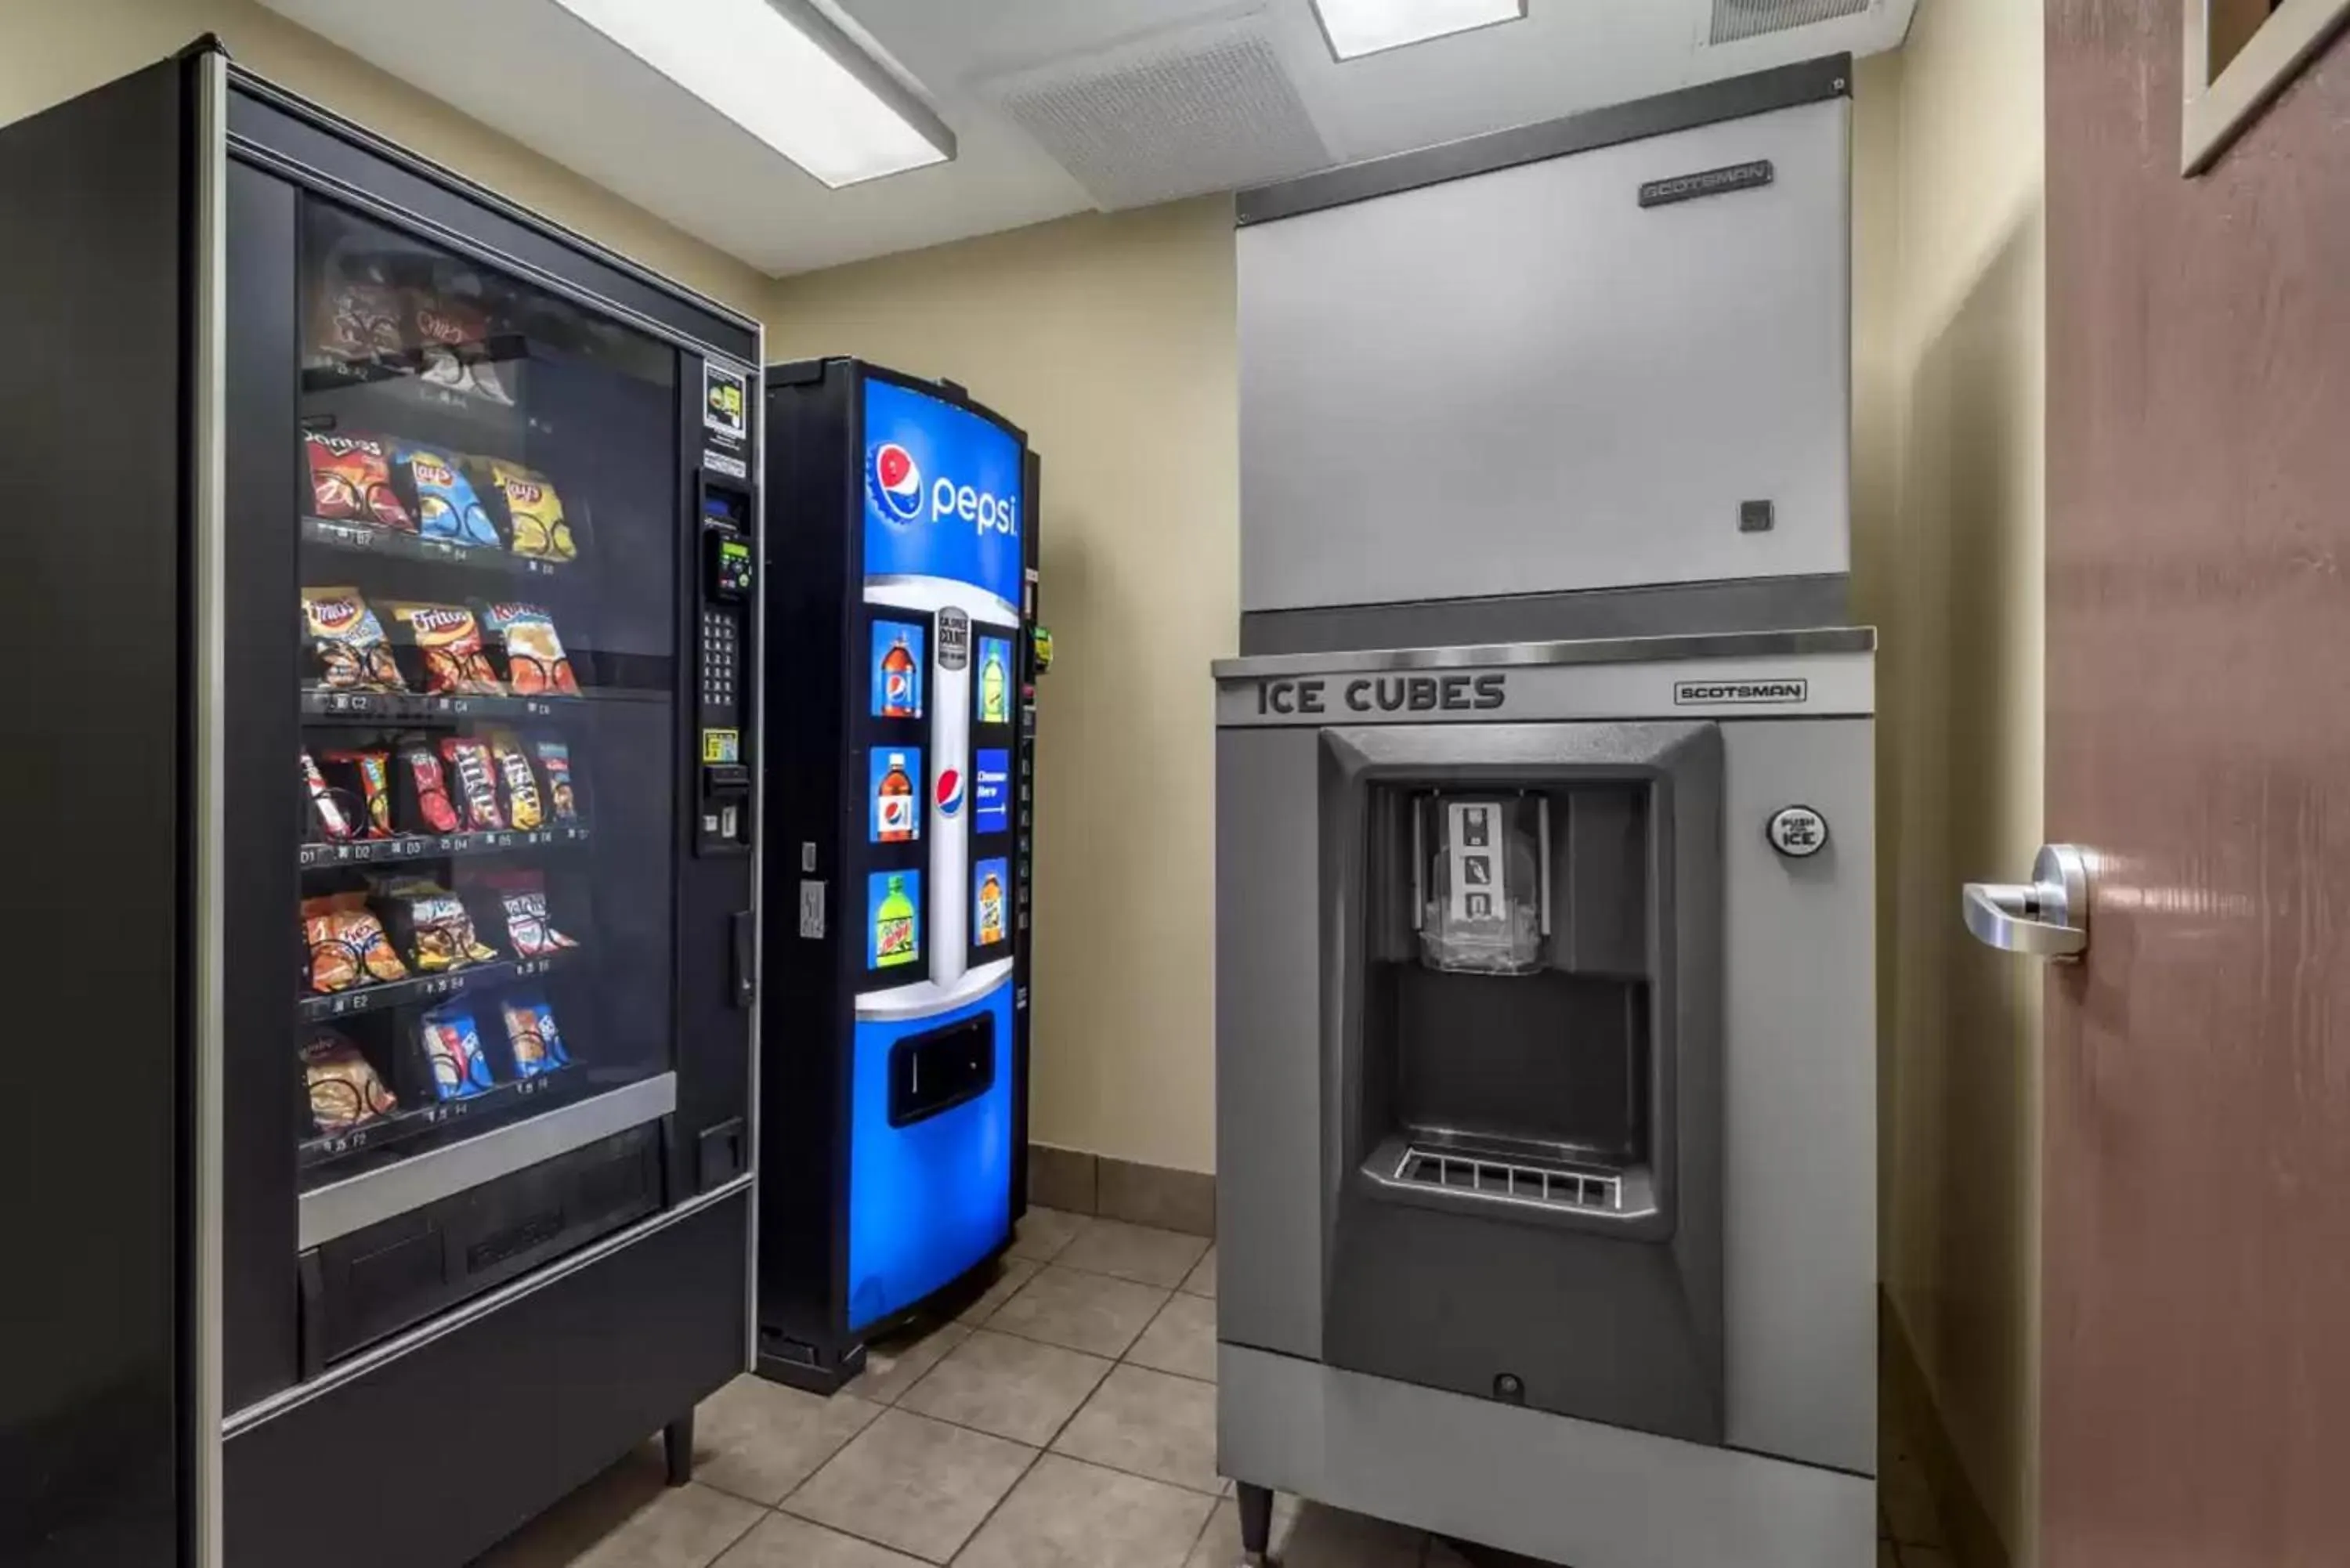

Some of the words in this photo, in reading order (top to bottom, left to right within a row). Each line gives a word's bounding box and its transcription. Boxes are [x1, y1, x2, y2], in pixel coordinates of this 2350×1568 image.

[1643, 164, 1765, 198] SCOTSMAN
[931, 477, 1017, 536] pepsi
[412, 609, 468, 632] Fritos
[1257, 679, 1325, 715] ICE
[1345, 674, 1506, 712] CUBES
[1680, 684, 1802, 699] SCOTSMAN
[454, 839, 468, 851] D4
[1783, 831, 1817, 847] ICE
[355, 845, 371, 859] D2
[407, 842, 421, 854] D3
[300, 851, 315, 863] D1
[353, 995, 368, 1009] E2
[352, 1133, 367, 1147] F2
